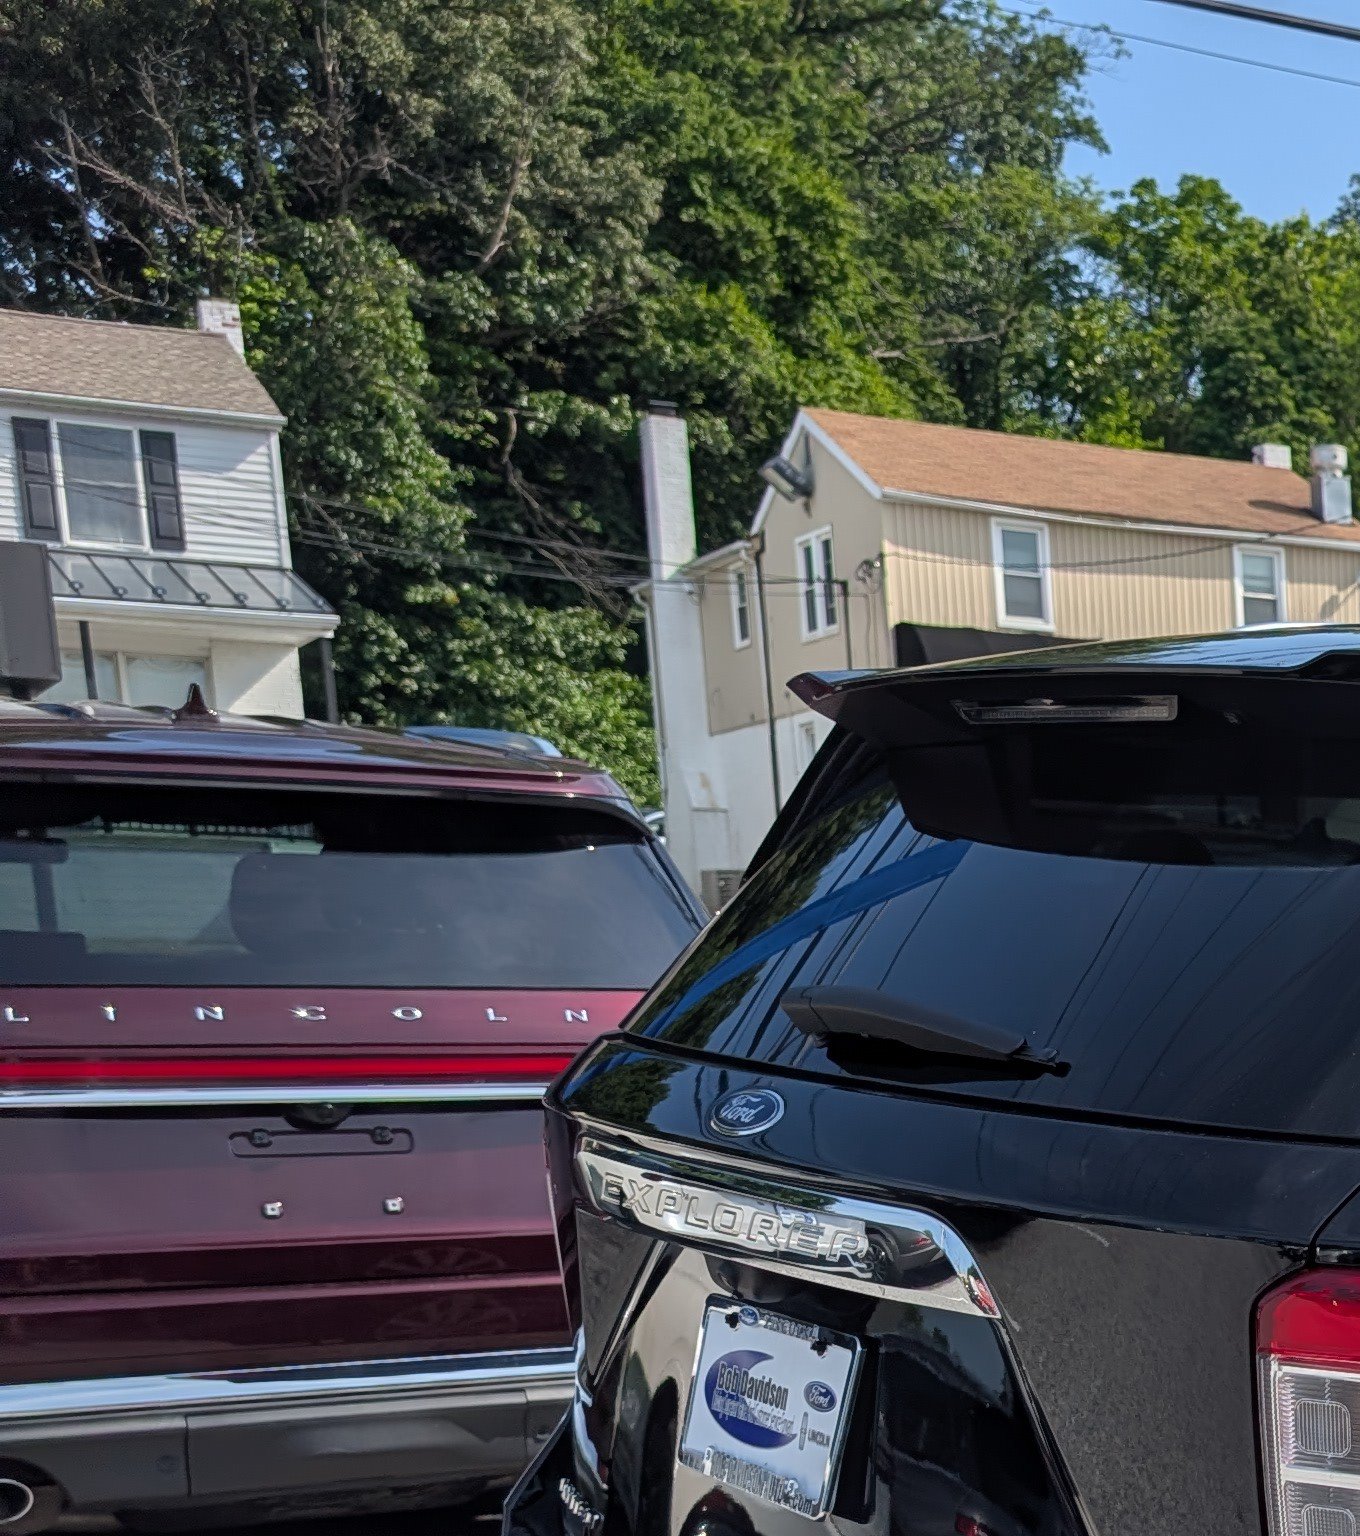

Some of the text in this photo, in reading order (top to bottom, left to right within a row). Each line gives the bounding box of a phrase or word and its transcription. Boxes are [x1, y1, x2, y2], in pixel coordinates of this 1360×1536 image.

[720, 1094, 765, 1123] Ford
[601, 1172, 873, 1278] EXPLORER
[718, 1361, 789, 1411] Bob Davidson
[808, 1384, 832, 1409] Ford
